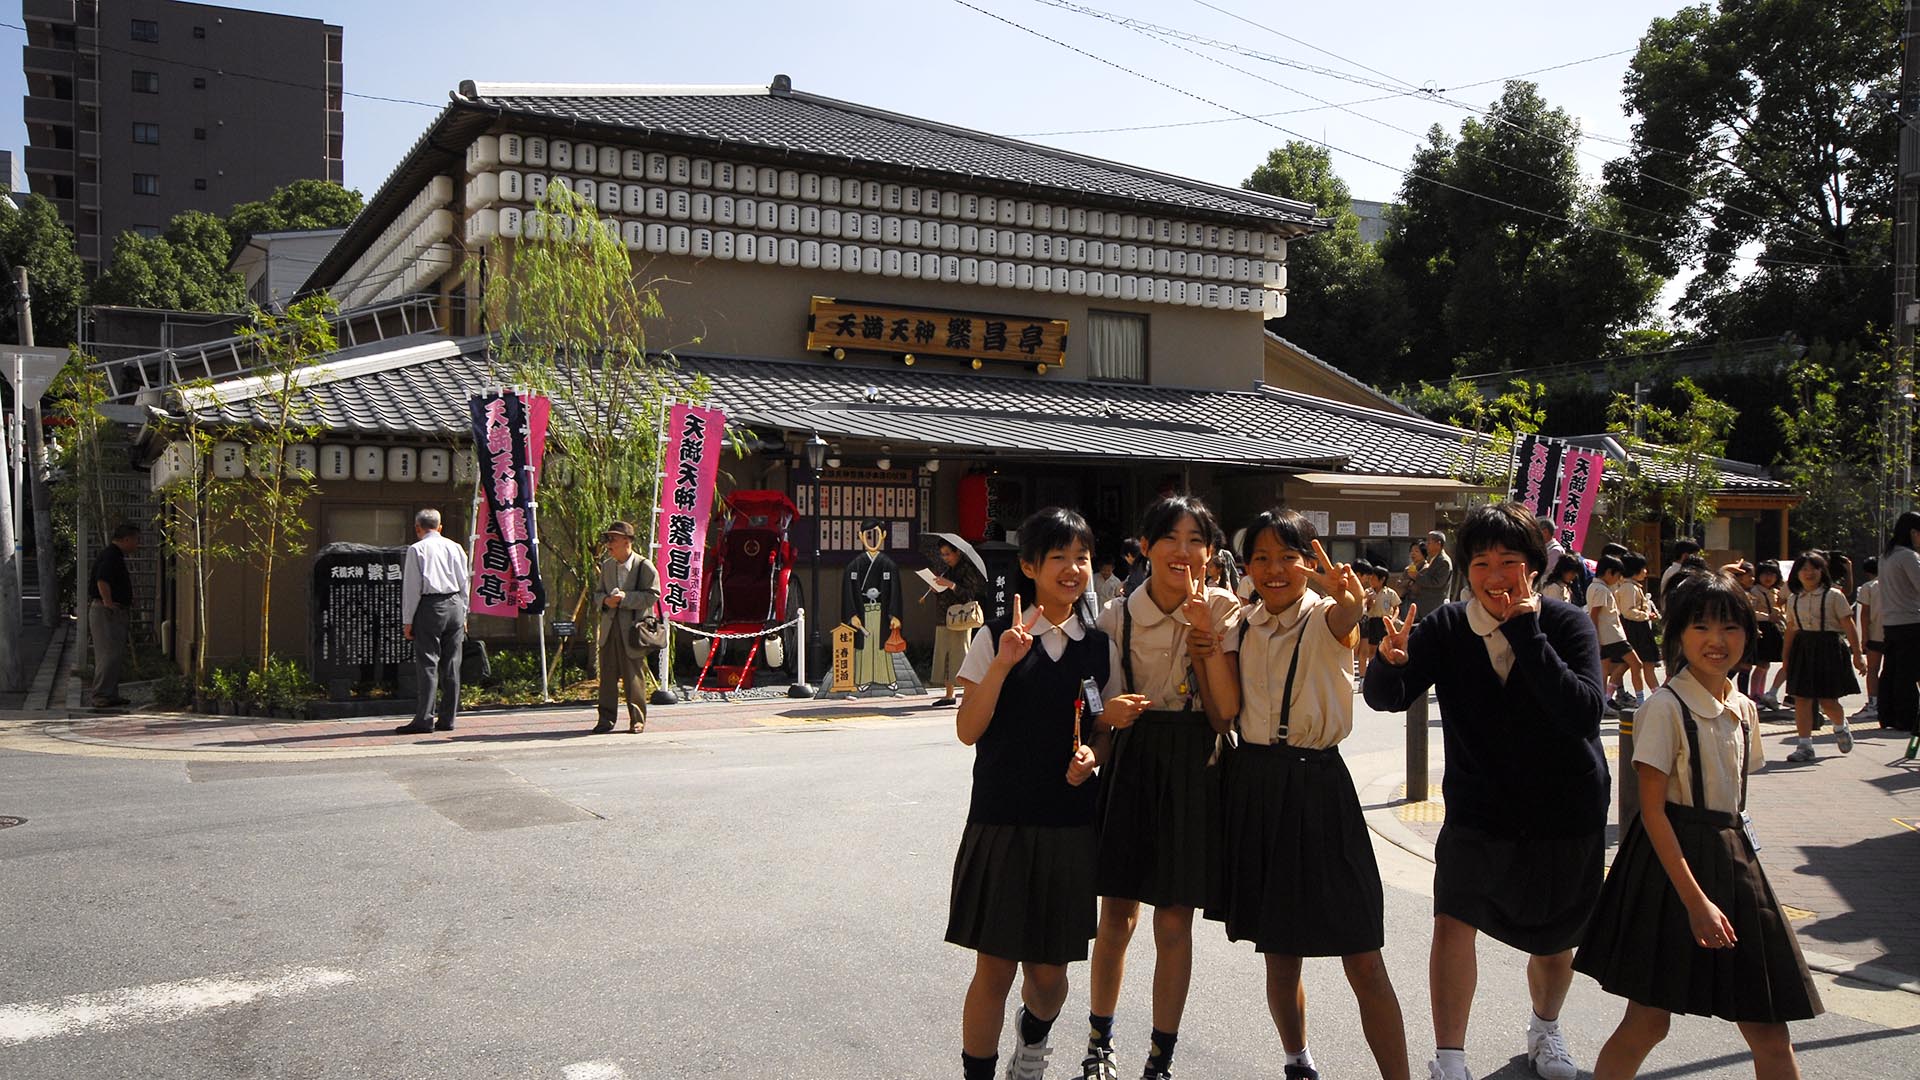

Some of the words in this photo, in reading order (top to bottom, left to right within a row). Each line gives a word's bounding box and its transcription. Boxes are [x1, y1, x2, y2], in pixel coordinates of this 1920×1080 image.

[835, 313, 1044, 354] 天満天神繁昌亭
